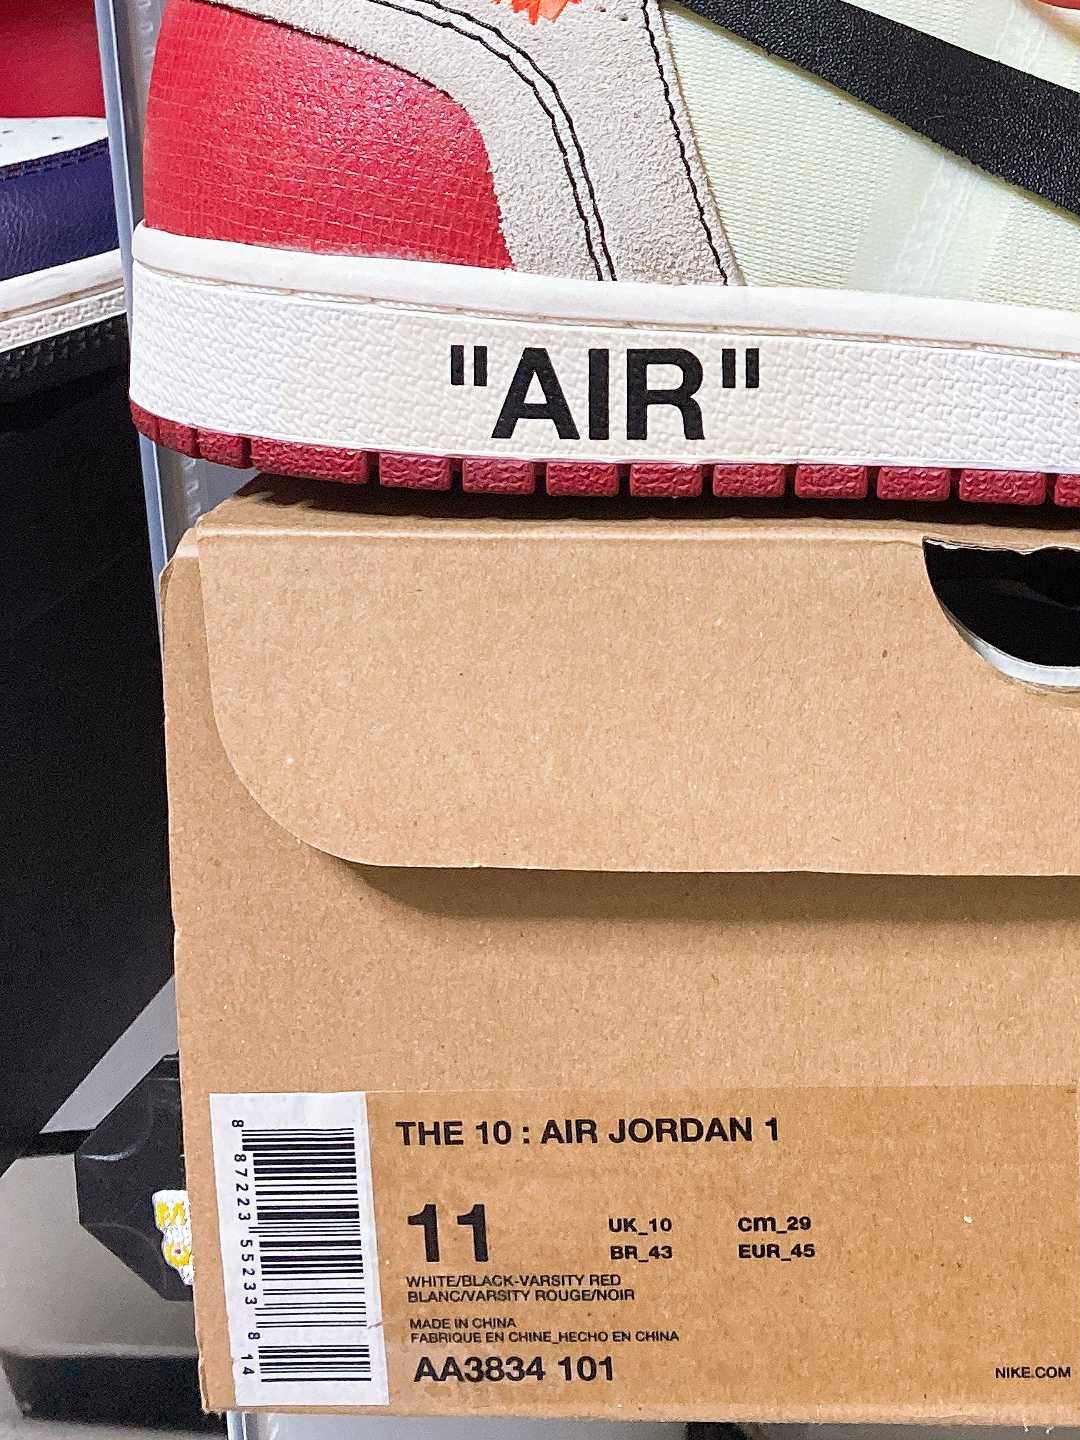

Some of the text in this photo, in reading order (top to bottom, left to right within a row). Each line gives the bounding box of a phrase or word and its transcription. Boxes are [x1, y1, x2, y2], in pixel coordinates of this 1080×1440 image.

[450, 345, 760, 441] "AIR"
[395, 1120, 465, 1146] THE
[475, 1120, 513, 1146] 10
[540, 1118, 598, 1145] AIR
[608, 1116, 753, 1144] JORDAN
[763, 1117, 779, 1141] 1
[231, 1118, 261, 1341] 8 87223 55233 8
[406, 1202, 490, 1264] 11
[608, 1217, 673, 1237] UK_10
[737, 1215, 812, 1235] cm_29
[609, 1244, 674, 1263] BR_43
[737, 1242, 816, 1263] EUR_45
[405, 1274, 622, 1288] WHITE/BLACK-VARSITY RED
[407, 1288, 636, 1303] BLANC/VARSITY ROUGE/NOIR
[409, 1317, 517, 1330] MADE IN CHINA
[410, 1330, 680, 1346] FABRIQUE EN CHINE_HECHO EN CHINA
[240, 1353, 256, 1376] 14
[413, 1355, 614, 1383] AA3834 101
[995, 1366, 1072, 1379] NIKE.COM
